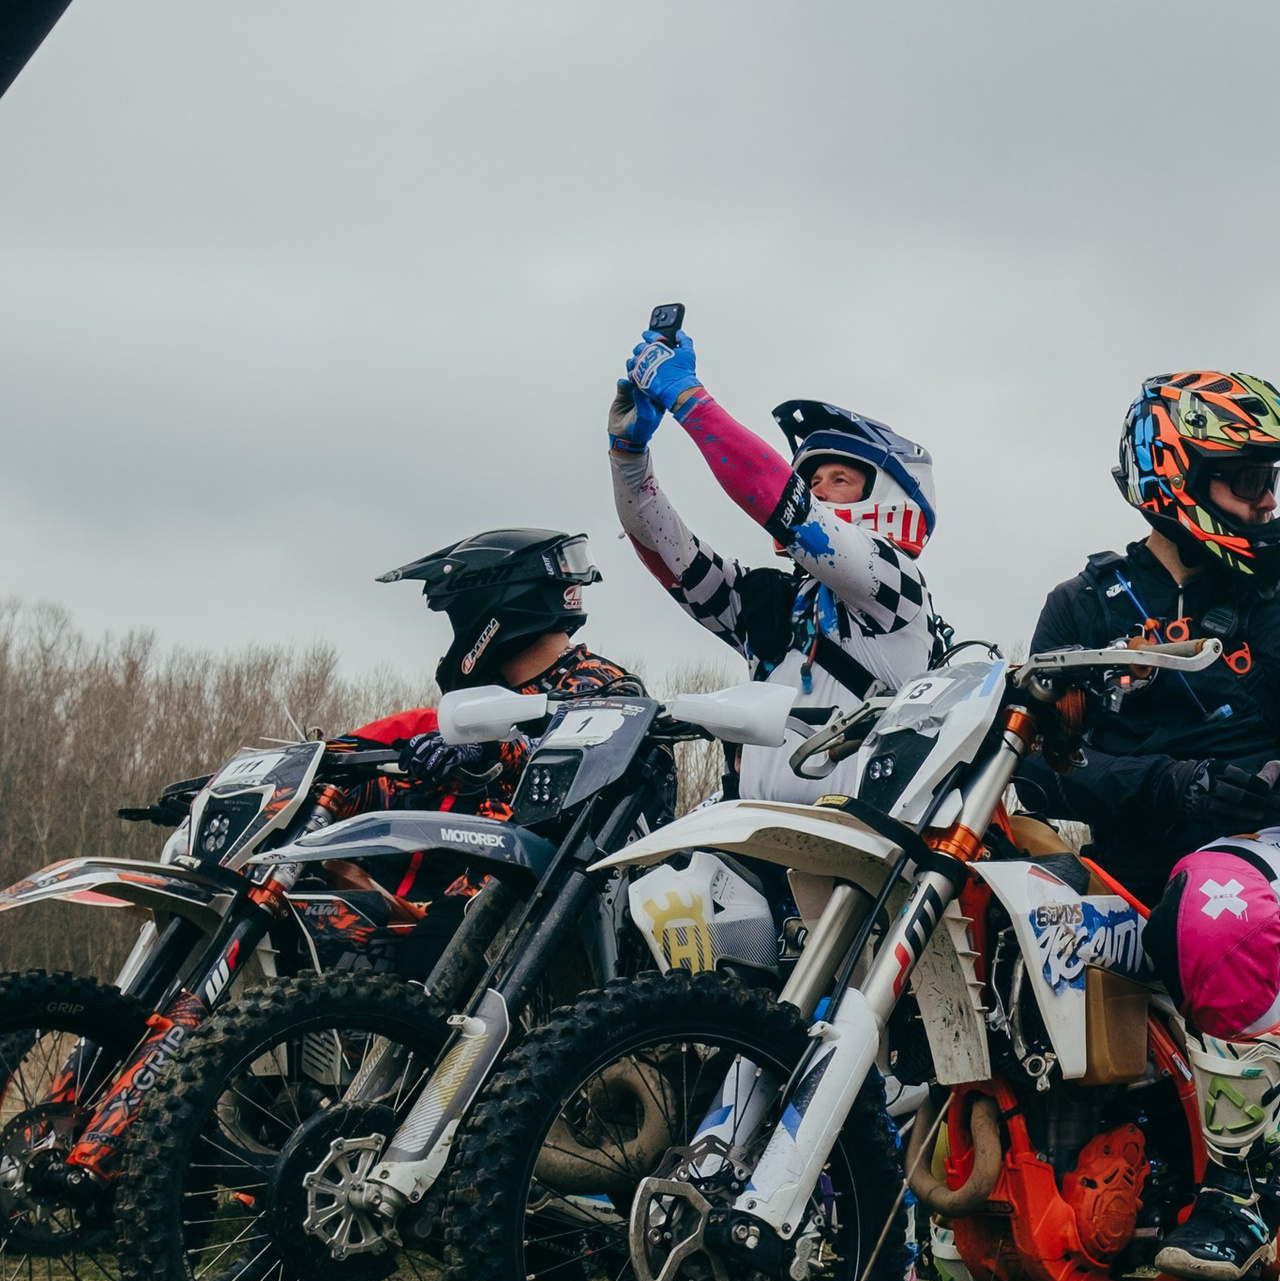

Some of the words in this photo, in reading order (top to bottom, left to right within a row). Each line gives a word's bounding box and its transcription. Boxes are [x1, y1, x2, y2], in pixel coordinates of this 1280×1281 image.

[904, 682, 932, 700] 13
[577, 716, 593, 733] 1
[231, 760, 265, 776] 111
[440, 828, 506, 848] MOTOREX
[304, 902, 339, 916] KTM
